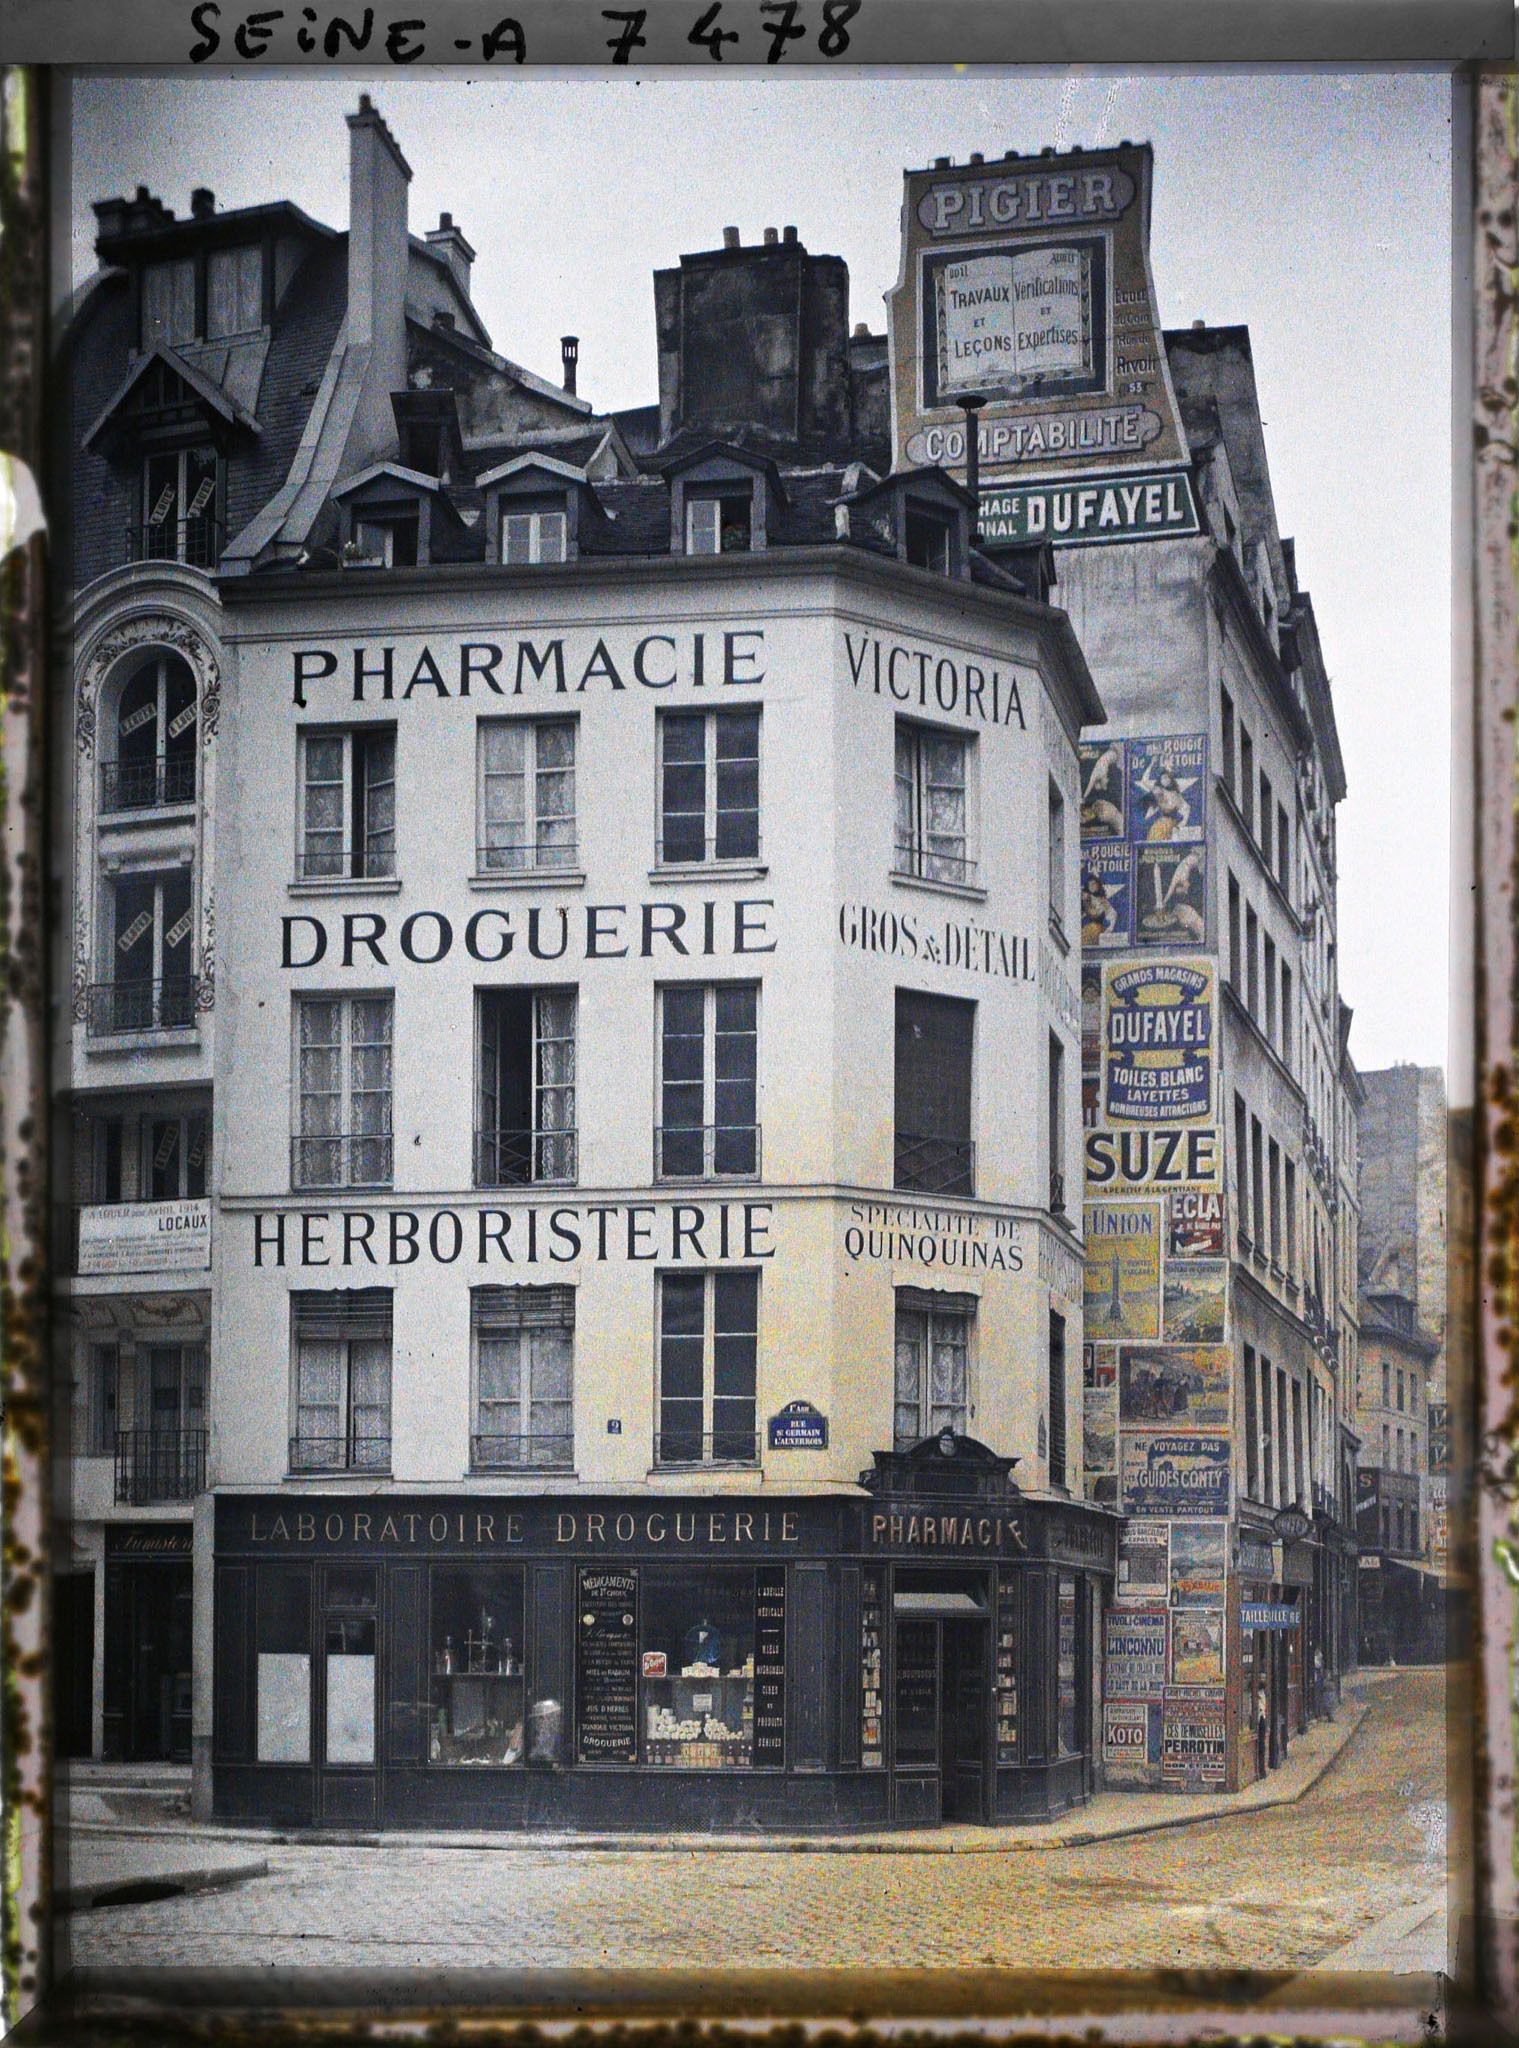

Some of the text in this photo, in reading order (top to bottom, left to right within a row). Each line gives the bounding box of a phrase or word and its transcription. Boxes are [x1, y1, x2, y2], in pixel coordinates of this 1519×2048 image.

[933, 175, 1114, 229] PIGIER
[951, 287, 1010, 309] TRAVAUX
[974, 317, 986, 328] ET
[1040, 307, 1052, 316] ET
[954, 336, 1012, 359] LEÇONS
[1018, 326, 1079, 351] Expertises
[1027, 482, 1185, 535] DUFAYEL
[292, 629, 766, 706] PHARMACIE
[843, 631, 1027, 731] VICTORIA
[1091, 845, 1131, 860] BOUGIE
[280, 898, 779, 969] DROGUERIE
[838, 902, 918, 960] GROS
[923, 934, 942, 965] &
[1114, 966, 1205, 993] GRANDS MAGASINS
[1110, 1009, 1206, 1045] DUFAYEL
[1160, 1065, 1204, 1089] BLANC
[1127, 1087, 1190, 1103] LAYETTES
[1086, 1130, 1216, 1182] SUZE
[1172, 1193, 1222, 1220] ECLA
[159, 1214, 208, 1231] LOCAUX
[994, 1219, 1020, 1241] DE
[254, 1203, 778, 1268] HERBORISTERIE
[844, 1227, 1023, 1272] QUINQUINAS
[785, 1428, 821, 1437] GERMAIN
[790, 1420, 807, 1428] RUE
[1135, 1441, 1221, 1453] NE VOYAGEZ PAS
[1138, 1469, 1180, 1489] GUIDES
[1180, 1469, 1223, 1489] CONTY
[1176, 1505, 1215, 1514] PARTOUT
[251, 1512, 524, 1543] LABORATOIRE
[556, 1512, 801, 1543] DROGUERIE
[872, 1514, 1028, 1551] PHARMACIE
[1107, 1637, 1164, 1656] L'INCONNU
[1108, 1724, 1143, 1744] KOTO
[1165, 1739, 1225, 1754] PERROTIN
